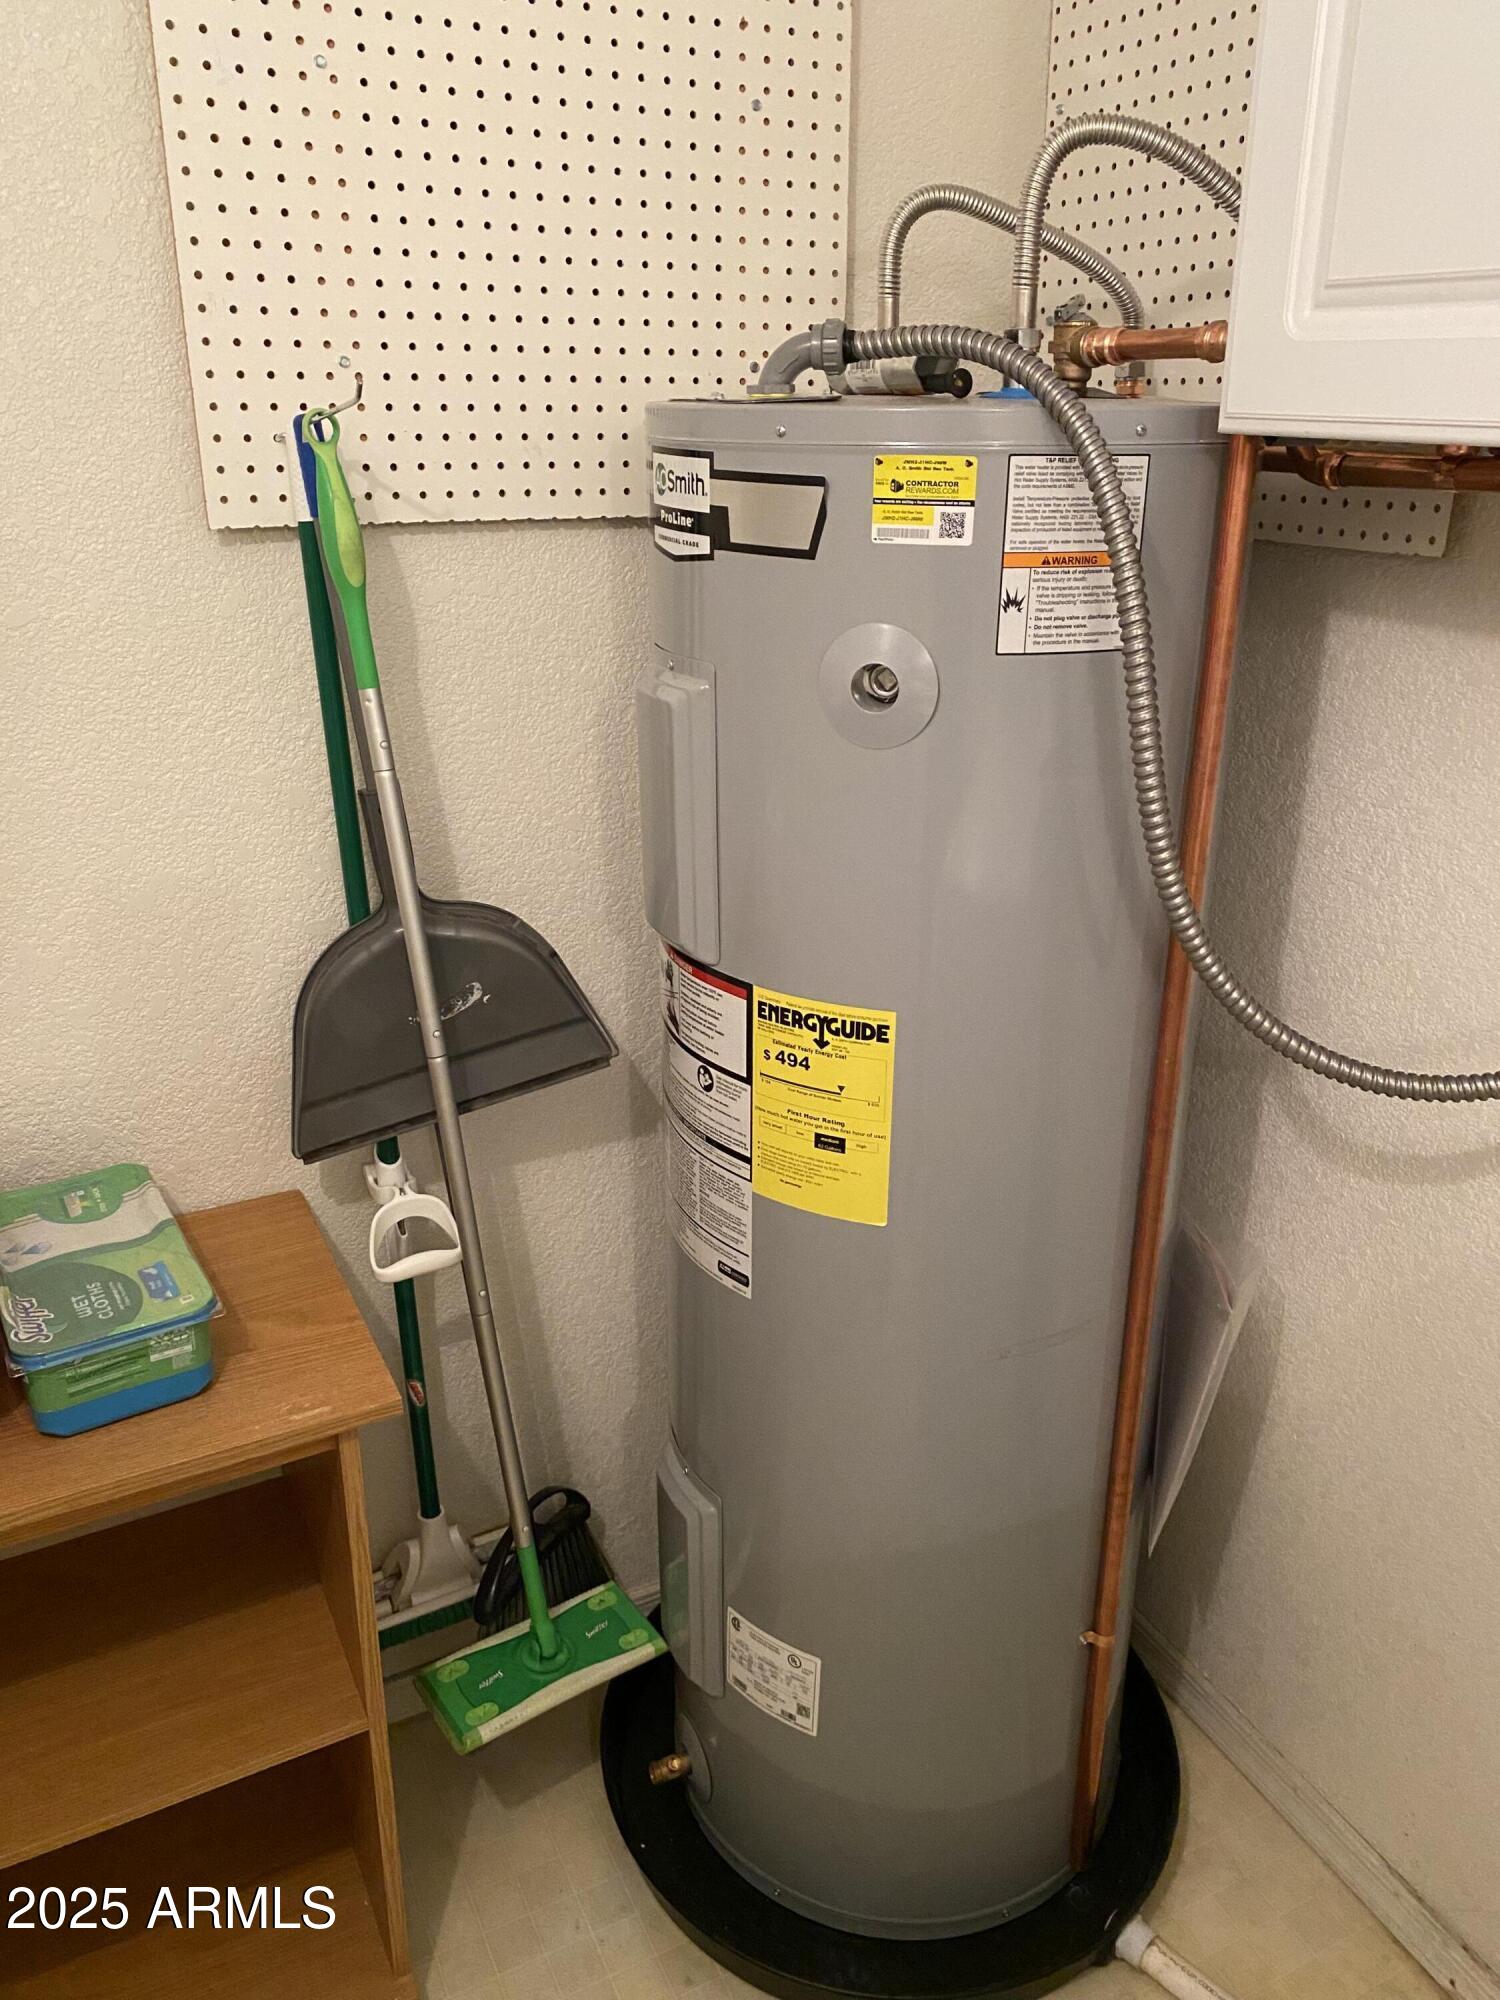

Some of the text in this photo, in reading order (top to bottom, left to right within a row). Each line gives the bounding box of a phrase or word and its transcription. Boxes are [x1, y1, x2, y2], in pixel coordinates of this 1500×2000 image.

[668, 470, 705, 496] Smith
[906, 480, 959, 488] CONTRACTOR
[906, 487, 959, 495] REWARDS.COM
[1052, 556, 1098, 565] WARNING
[758, 1000, 890, 1050] ENERGYGUIDE
[772, 1039, 796, 1050] Estimated
[798, 1045, 814, 1054] Yearly
[815, 1049, 833, 1058] Energy
[763, 1049, 811, 1071] $ 494
[787, 1108, 802, 1118] First
[822, 1118, 846, 1128] Rating
[71, 1295, 93, 1319] WET
[86, 1282, 114, 1319] CLOTHS
[8, 1296, 54, 1342] Swiffer
